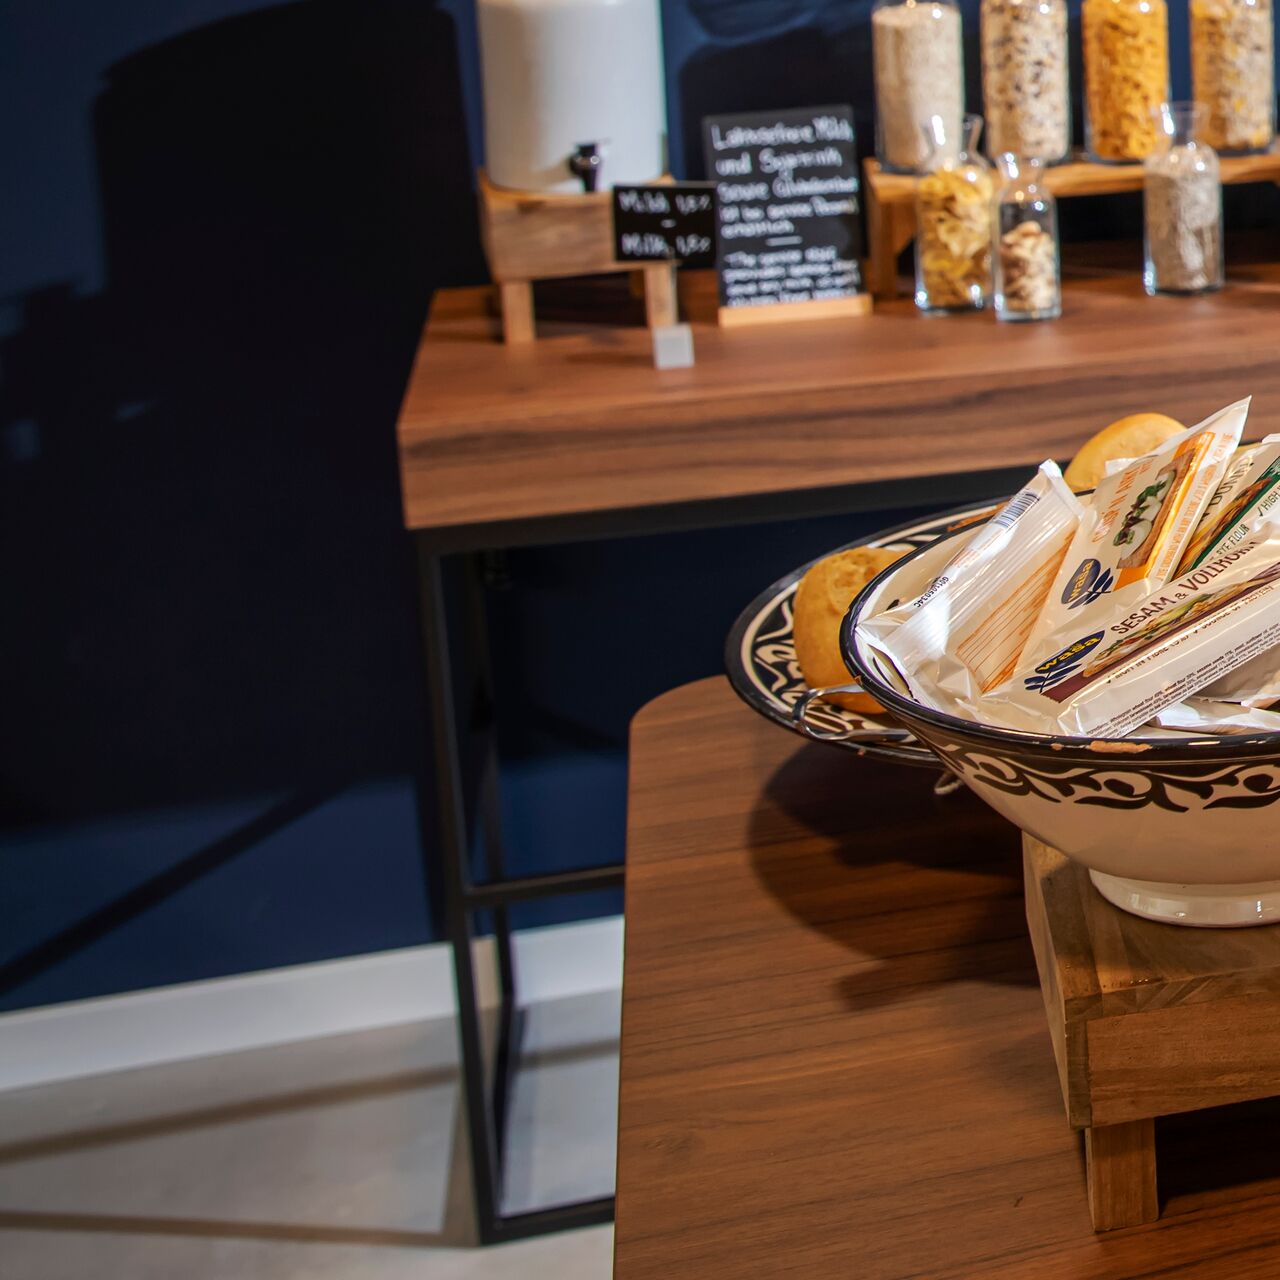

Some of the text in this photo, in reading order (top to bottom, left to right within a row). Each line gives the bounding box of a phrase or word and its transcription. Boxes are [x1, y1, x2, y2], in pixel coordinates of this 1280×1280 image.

[1262, 490, 1280, 512] HIGH
[1110, 596, 1176, 635] SESAM
[1175, 588, 1189, 602] &
[1036, 635, 1102, 673] wasa
